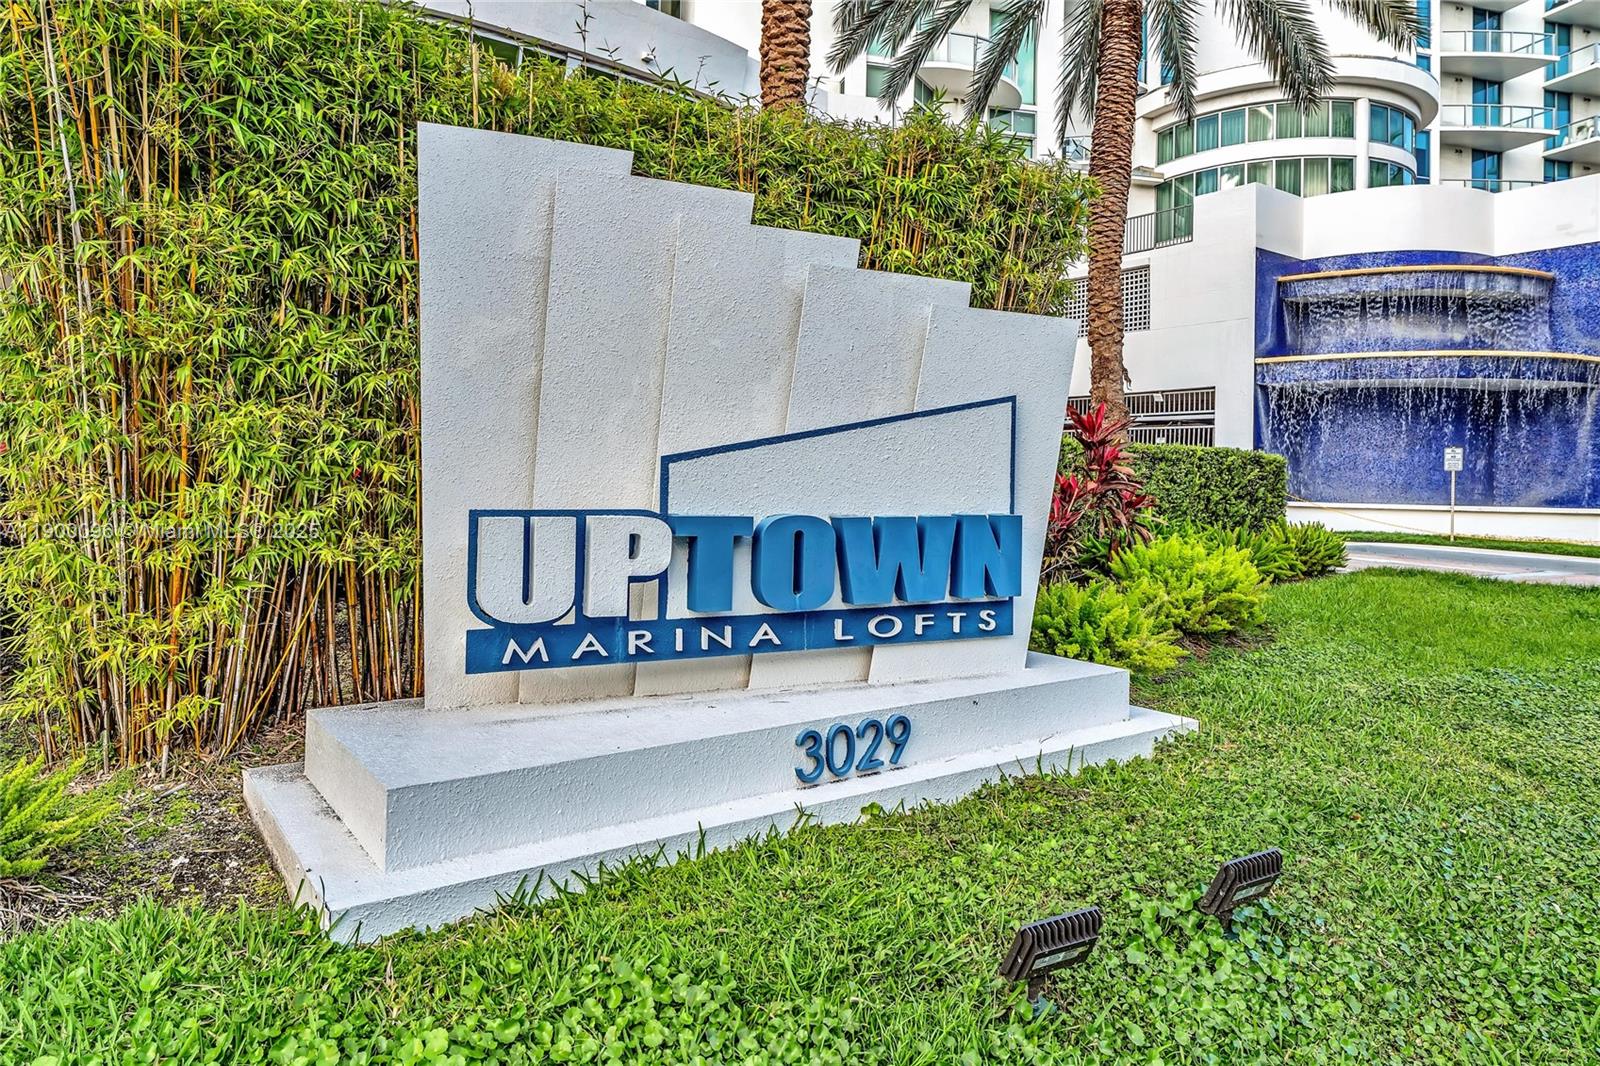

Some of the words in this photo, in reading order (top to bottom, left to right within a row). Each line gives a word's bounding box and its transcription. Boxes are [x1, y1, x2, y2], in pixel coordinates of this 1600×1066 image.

[475, 513, 1022, 625] UPTOWN
[501, 621, 781, 665] MARINA
[833, 610, 997, 641] LOFTS
[794, 713, 912, 784] 3029
